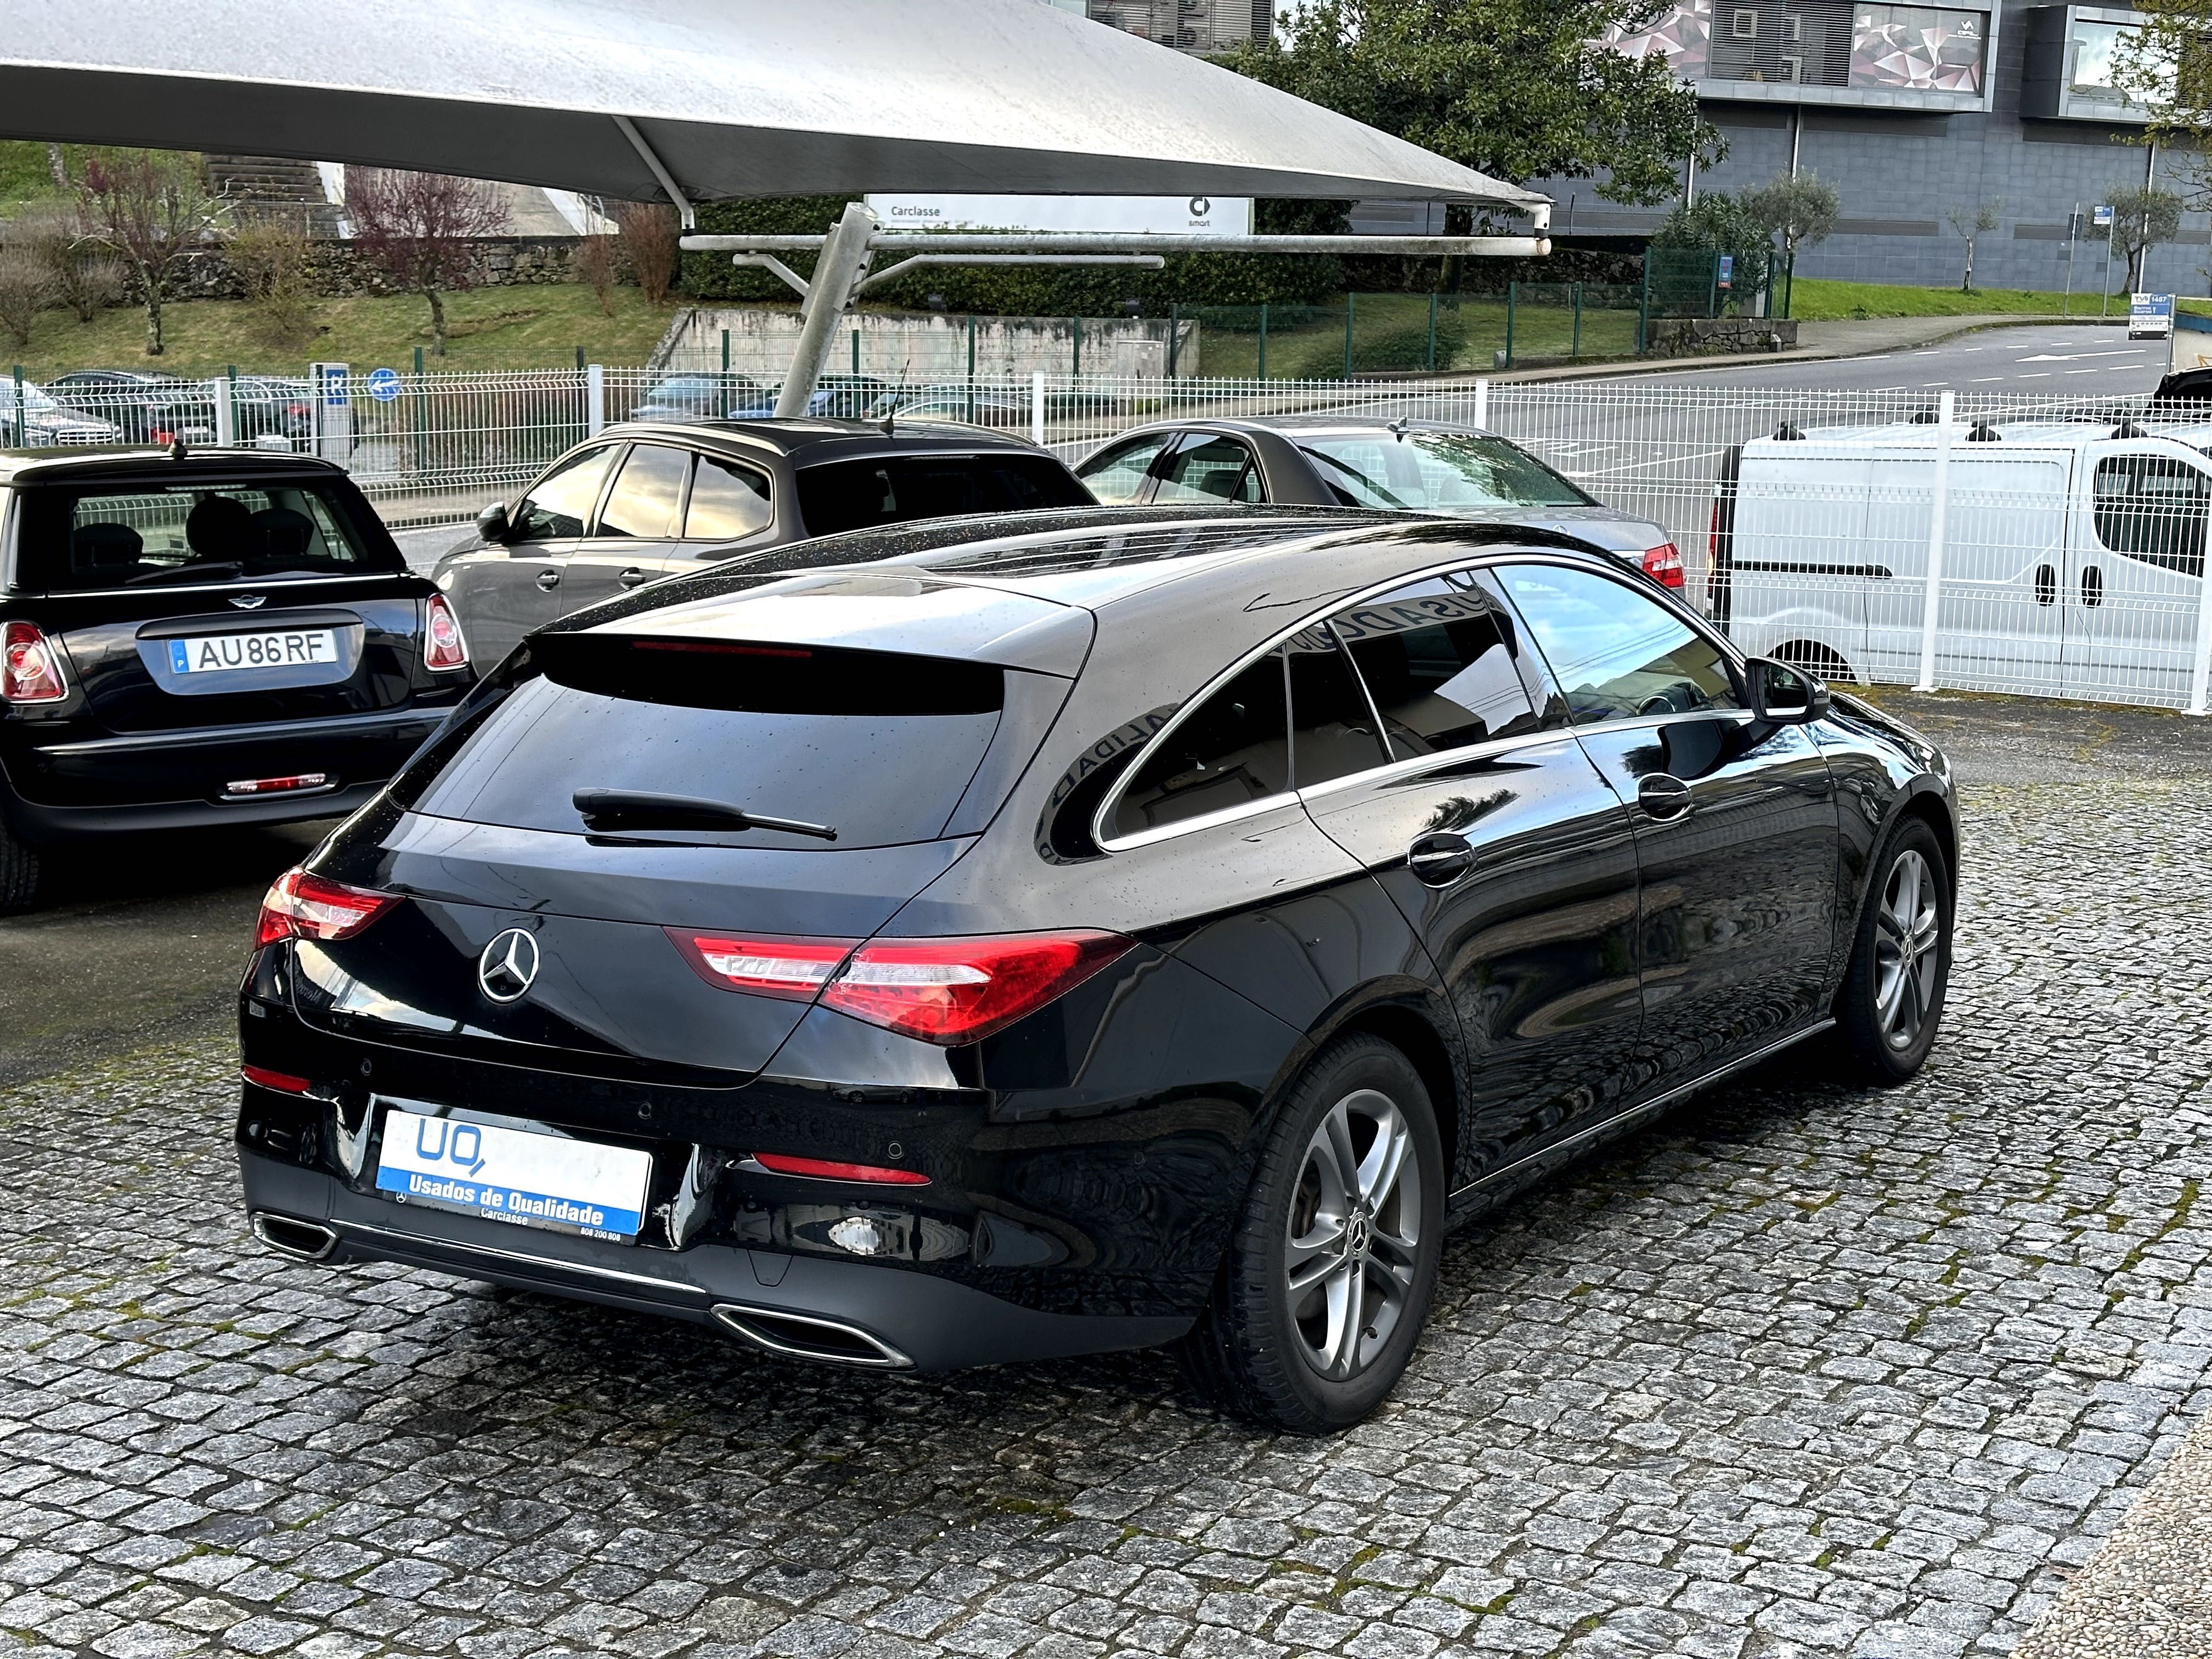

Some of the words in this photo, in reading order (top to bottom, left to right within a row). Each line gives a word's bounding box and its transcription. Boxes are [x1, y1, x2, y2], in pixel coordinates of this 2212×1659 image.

[891, 206, 940, 216] Carclasse
[409, 1173, 476, 1203] Usados
[480, 1188, 504, 1207] de
[508, 1192, 604, 1226] Qualidade
[481, 1207, 528, 1226] Carclasse
[580, 1227, 593, 1237] 808
[594, 1229, 607, 1239] 200
[608, 1232, 620, 1242] 808
